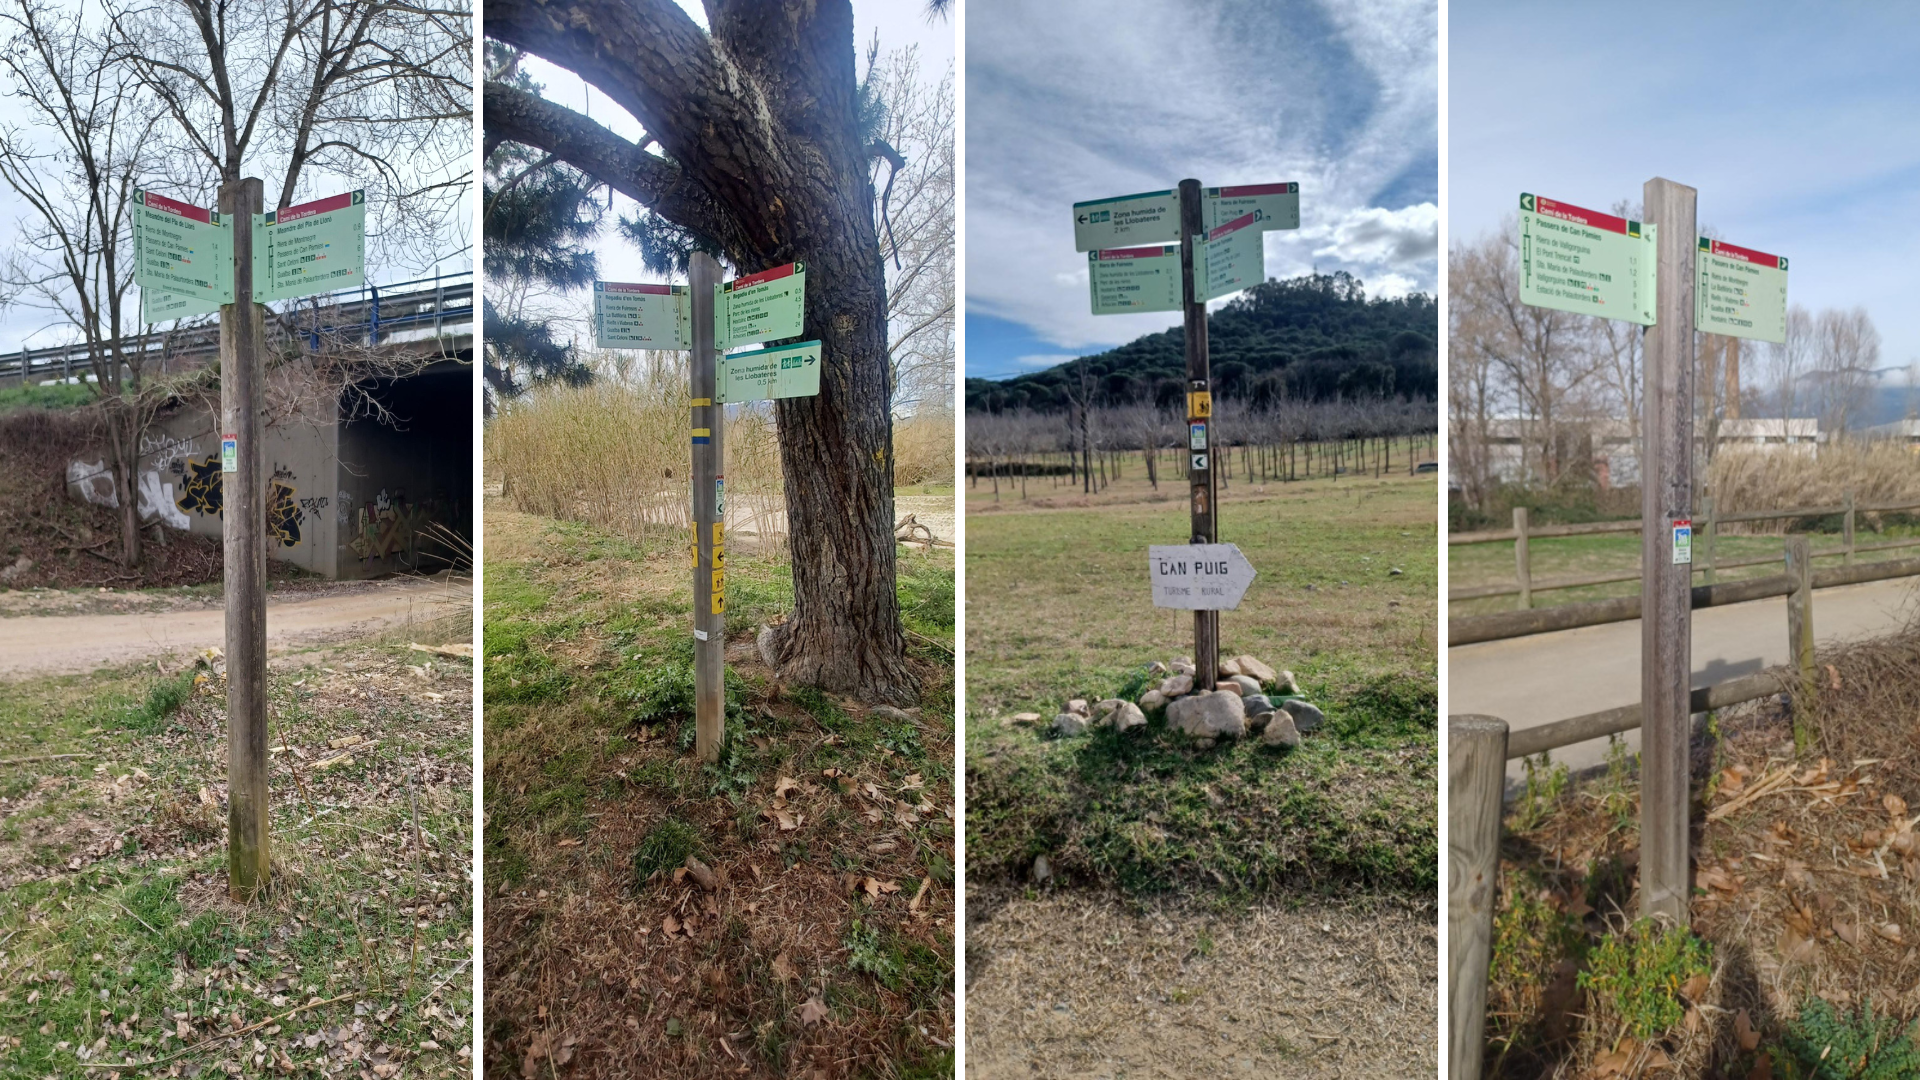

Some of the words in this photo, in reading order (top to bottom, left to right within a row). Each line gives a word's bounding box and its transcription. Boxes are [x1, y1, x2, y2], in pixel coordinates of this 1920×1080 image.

[301, 209, 316, 218] Tordera
[1131, 207, 1156, 216] humida
[1125, 214, 1160, 225] Llobateres
[1569, 214, 1588, 225] Tordera
[277, 225, 296, 234] Meandre
[1537, 219, 1559, 232] Passera
[1570, 226, 1580, 236] Can
[746, 364, 768, 372] humida
[745, 371, 777, 380] Llobateres
[1160, 562, 1187, 575] CAN
[1195, 562, 1228, 575] PUIG
[1164, 587, 1191, 596] TURISME
[1202, 587, 1225, 596] RURAL
